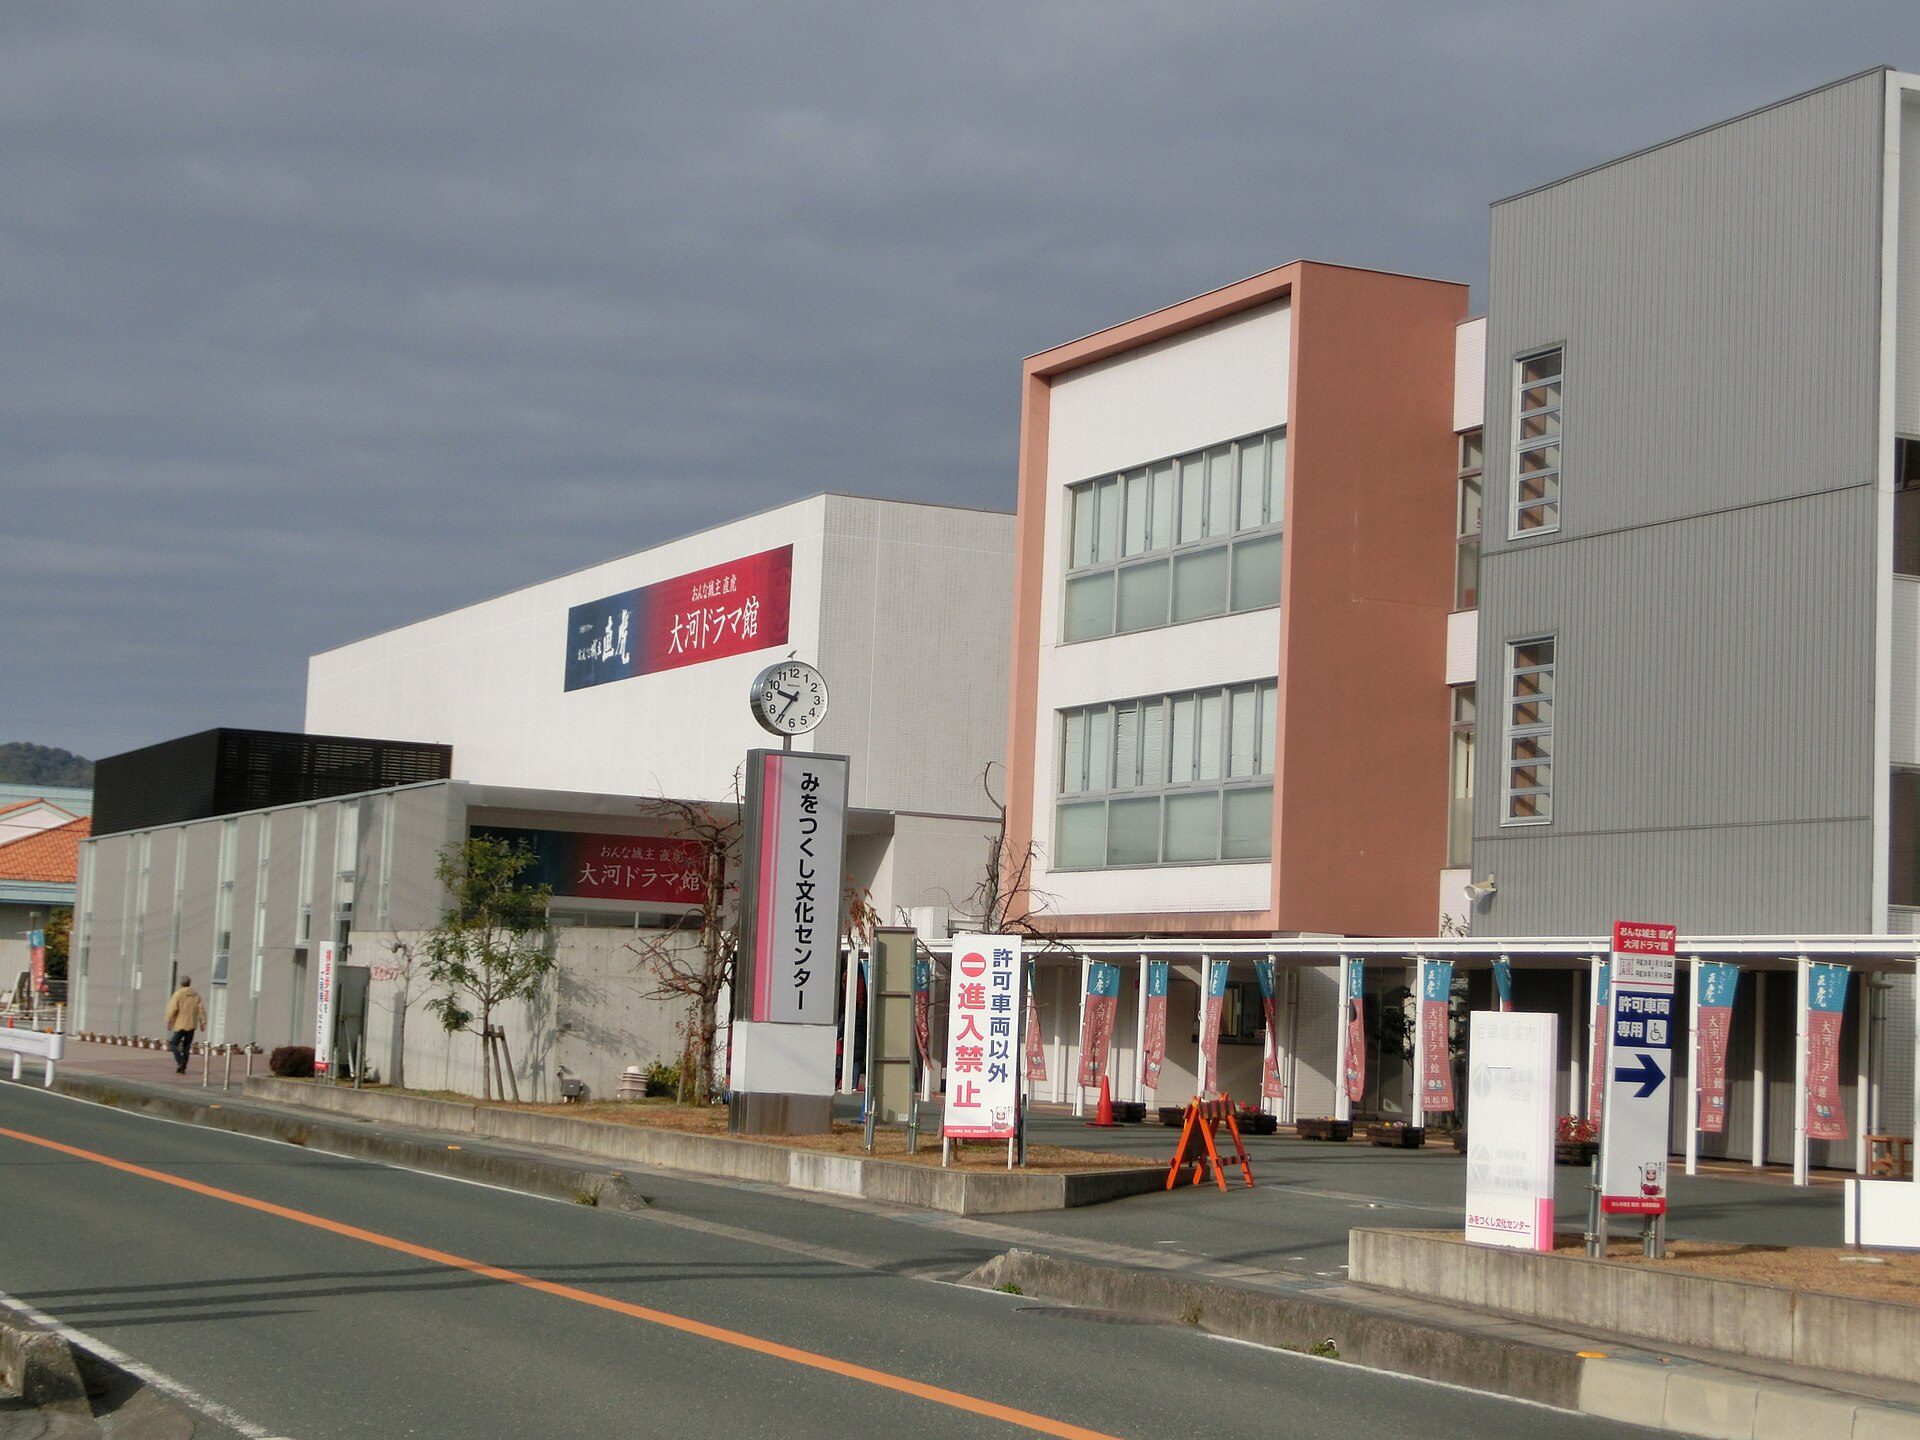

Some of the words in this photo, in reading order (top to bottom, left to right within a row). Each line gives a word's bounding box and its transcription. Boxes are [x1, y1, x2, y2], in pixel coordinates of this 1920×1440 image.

[668, 595, 759, 654] 大河ドラマ館
[777, 671, 787, 681] 11
[789, 668, 800, 678] 12
[804, 673, 809, 683] 1
[769, 680, 780, 690] 10
[810, 682, 818, 692] 2
[765, 691, 773, 701] 9
[813, 695, 821, 705] 3
[769, 704, 776, 714] 8
[808, 707, 816, 717] 4
[788, 718, 796, 728] 6
[800, 715, 807, 725] 5
[601, 845, 655, 861] おんな城主
[577, 862, 701, 891] 大河ドラマ館
[793, 772, 819, 1010] みをつくし文化センター
[1623, 939, 1669, 951] 大河ドラマ館
[1618, 995, 1671, 1015] 許可車両
[987, 948, 1013, 1084] 許可車両以外
[1617, 1020, 1644, 1038] 専用
[953, 983, 987, 1108] 進入禁止
[1429, 1008, 1440, 1074] 大河ドラマ館
[1468, 1214, 1531, 1231] みをつくし文化センター
